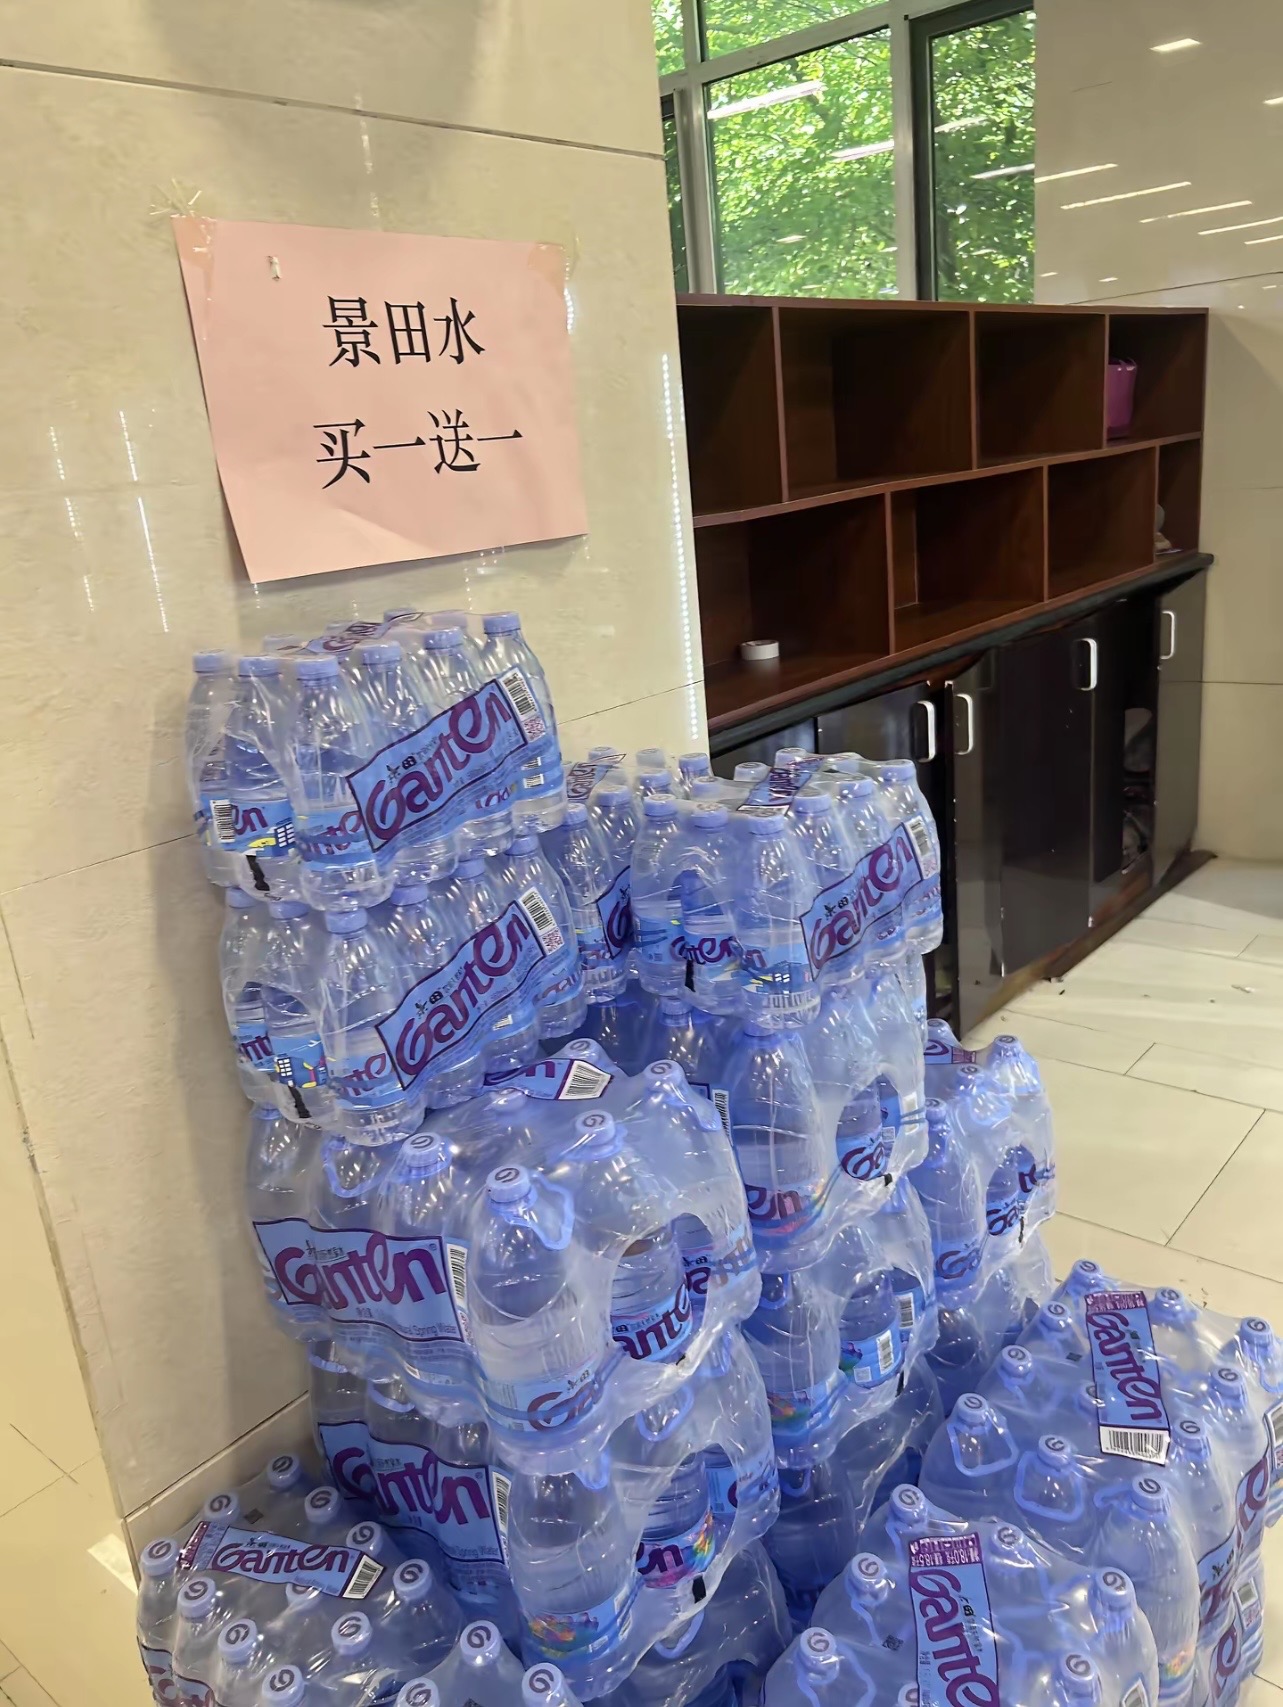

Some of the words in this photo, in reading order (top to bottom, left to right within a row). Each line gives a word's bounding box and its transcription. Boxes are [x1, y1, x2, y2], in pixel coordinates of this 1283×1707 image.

[322, 295, 486, 369] 景田水
[313, 408, 523, 490] 买一送一
[366, 692, 512, 840] Ganten
[810, 836, 914, 970] Ganten
[396, 913, 531, 1075] Ganten
[274, 1232, 447, 1311] Ganten
[1086, 1312, 1163, 1421] Ganten
[332, 1446, 491, 1526] Ganten
[211, 1542, 350, 1575] Ganten
